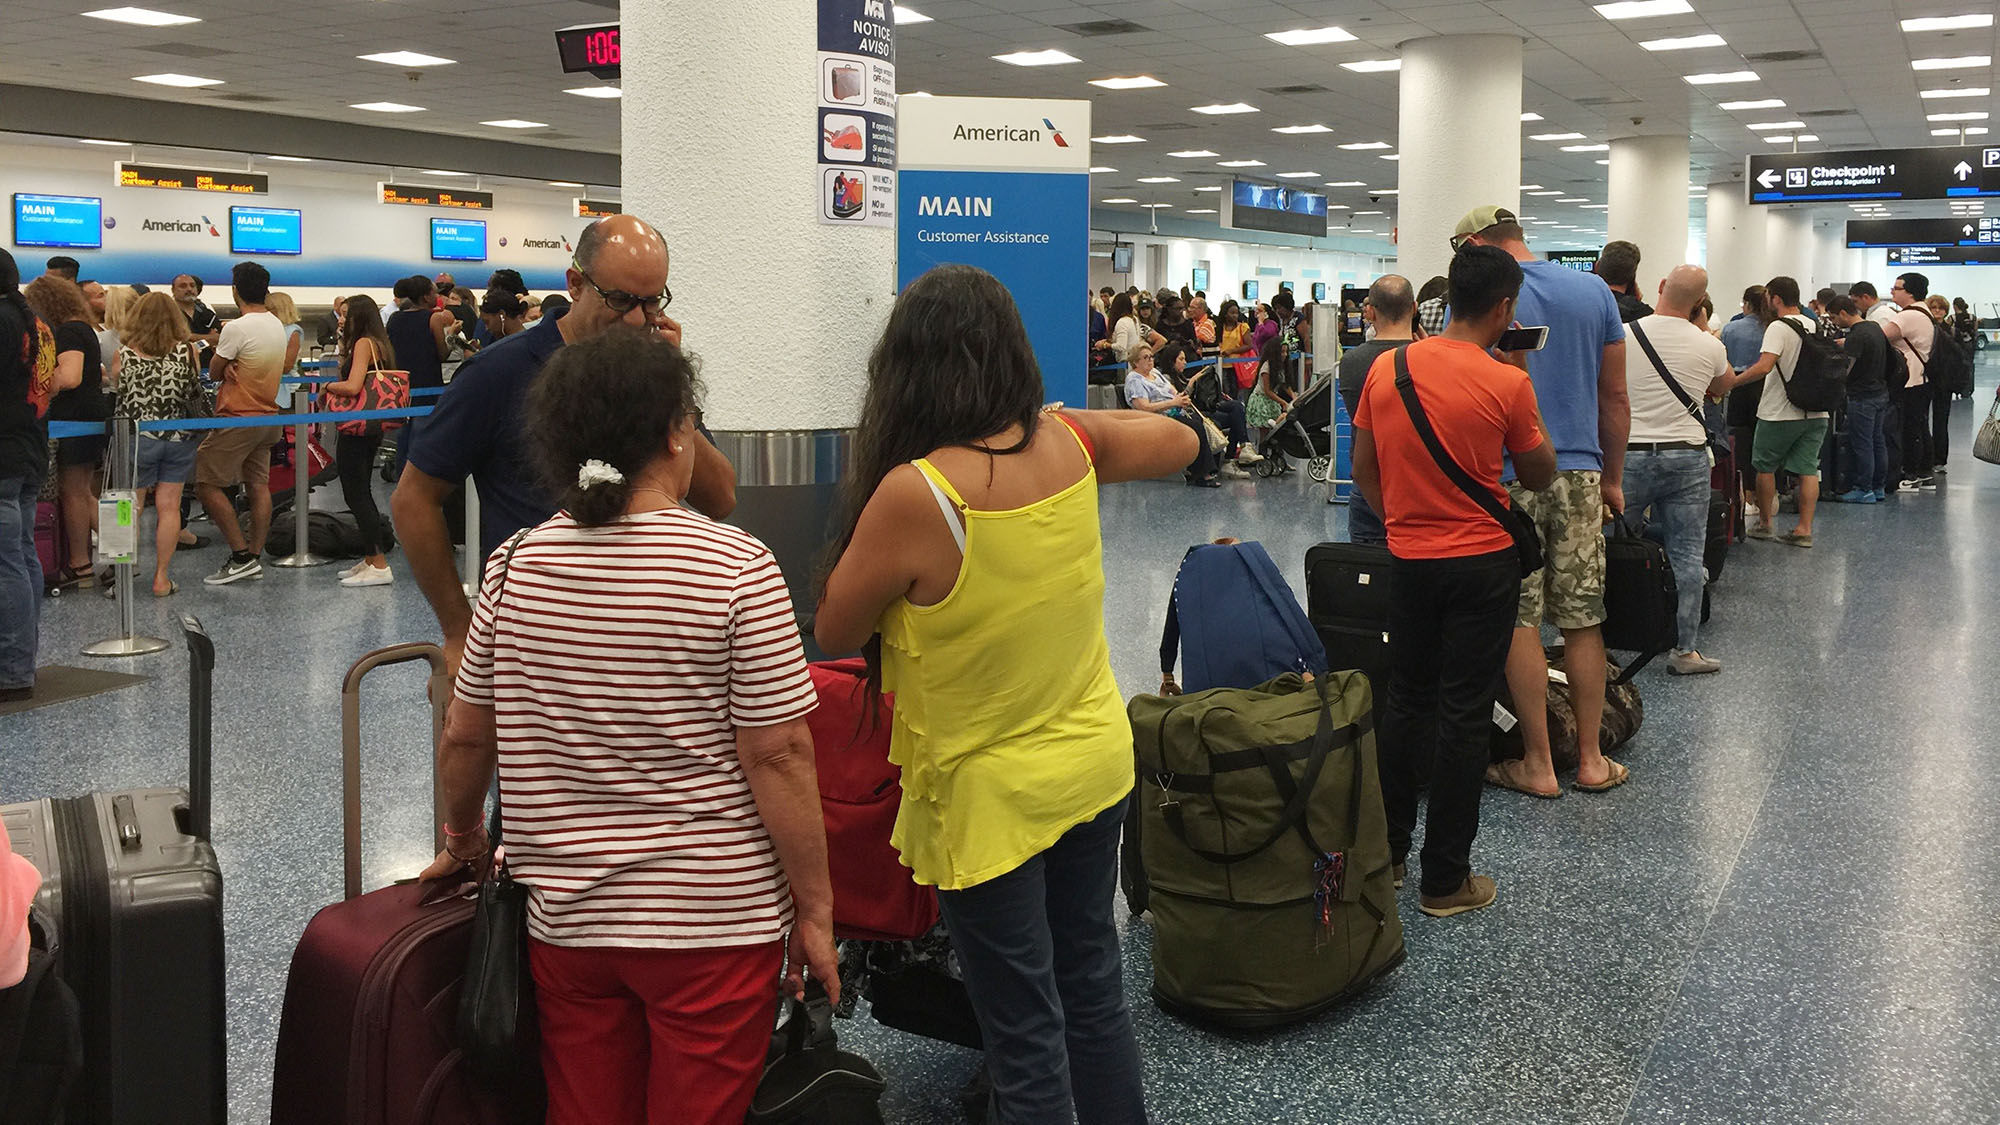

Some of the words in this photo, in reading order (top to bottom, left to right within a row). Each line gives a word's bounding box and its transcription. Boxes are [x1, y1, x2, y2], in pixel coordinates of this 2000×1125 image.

[854, 20, 890, 41] NOTICE
[586, 30, 620, 64] 1:06
[859, 38, 888, 56] AVISO
[954, 124, 1040, 142] American
[1811, 165, 1885, 179] Checkpoint
[1889, 164, 1895, 175] 1
[22, 205, 55, 215] MAIN
[918, 196, 992, 216] MAIN
[142, 219, 201, 233] American
[237, 216, 264, 225] MAIN
[522, 238, 560, 249] American
[918, 230, 981, 242] Customer
[984, 230, 1049, 244] Assistance
